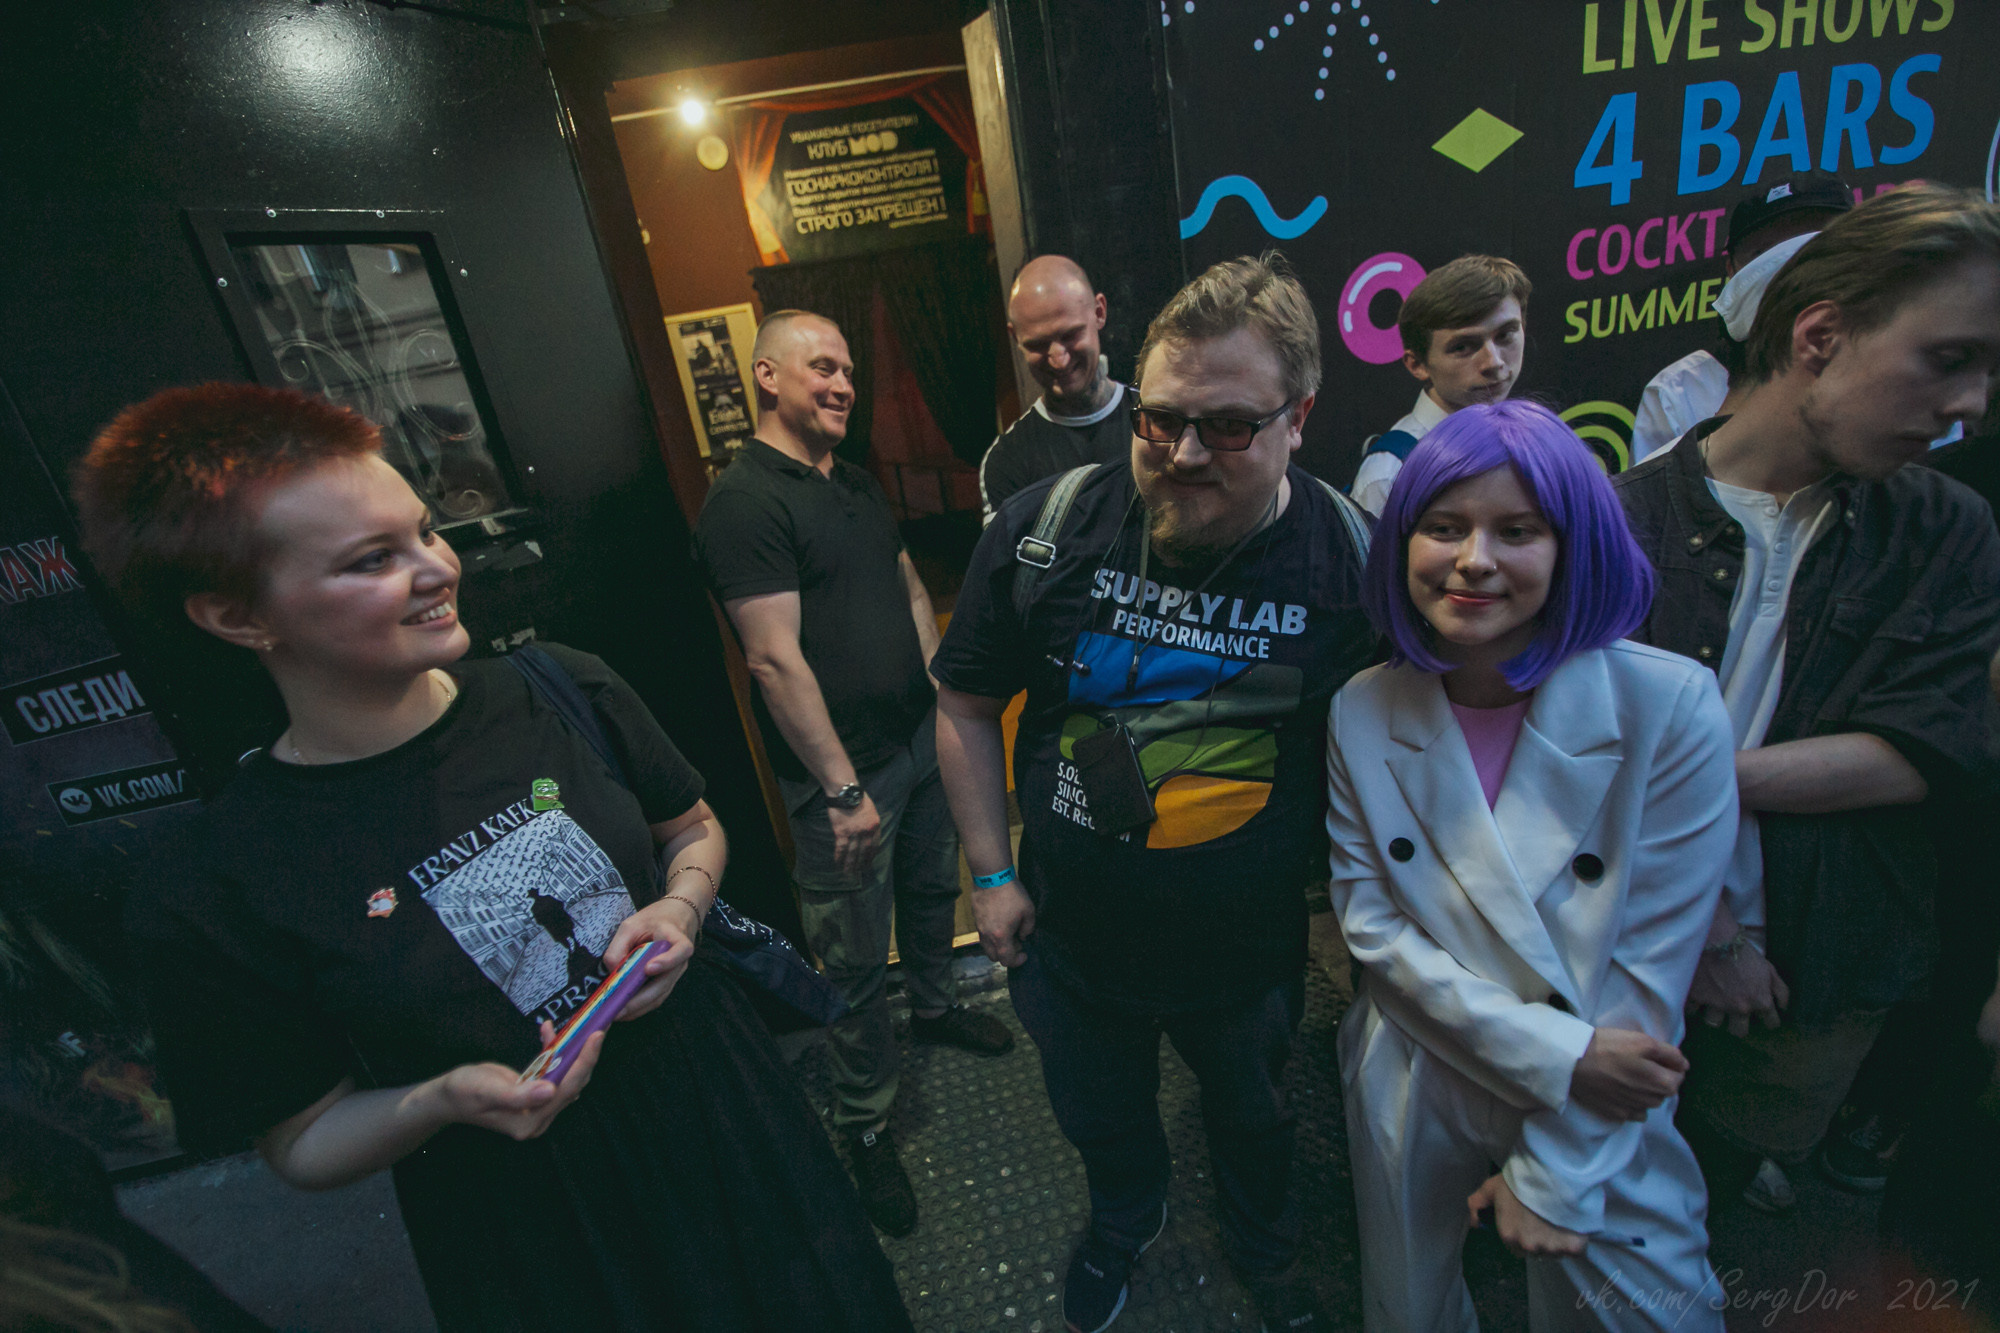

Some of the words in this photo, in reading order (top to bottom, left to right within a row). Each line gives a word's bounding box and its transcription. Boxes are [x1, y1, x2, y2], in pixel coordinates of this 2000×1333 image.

[1583, 0, 1720, 74] LIVE
[807, 139, 849, 160] КЛУБ
[1574, 92, 1643, 206] 4
[1677, 54, 1942, 196] BARS
[795, 210, 854, 235] СТРОГО
[1566, 208, 1730, 281] COCKT
[1564, 277, 1731, 344] SUMME
[1091, 568, 1226, 625] SUPPLY
[1229, 599, 1308, 635] LAB
[1112, 609, 1270, 659] PERFORMANCE
[15, 669, 146, 734] СЛЕДИ
[1052, 795, 1070, 818] EST.
[407, 829, 487, 890] FRANZ
[480, 796, 540, 842] KAFK
